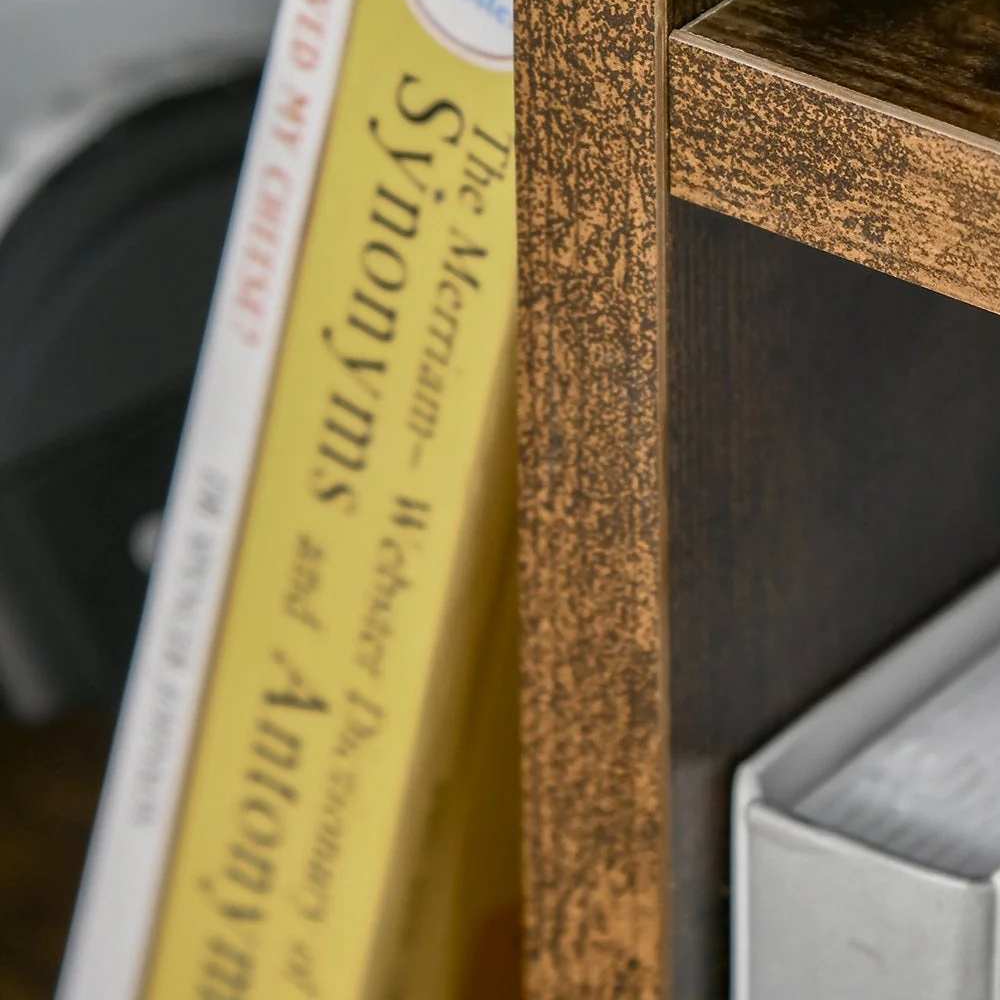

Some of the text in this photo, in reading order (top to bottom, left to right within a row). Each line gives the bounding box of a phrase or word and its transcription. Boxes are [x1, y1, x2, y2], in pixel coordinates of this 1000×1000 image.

[269, 82, 312, 152] MY
[458, 124, 512, 216] The
[310, 73, 466, 516] Synonyms
[283, 534, 325, 634] and
